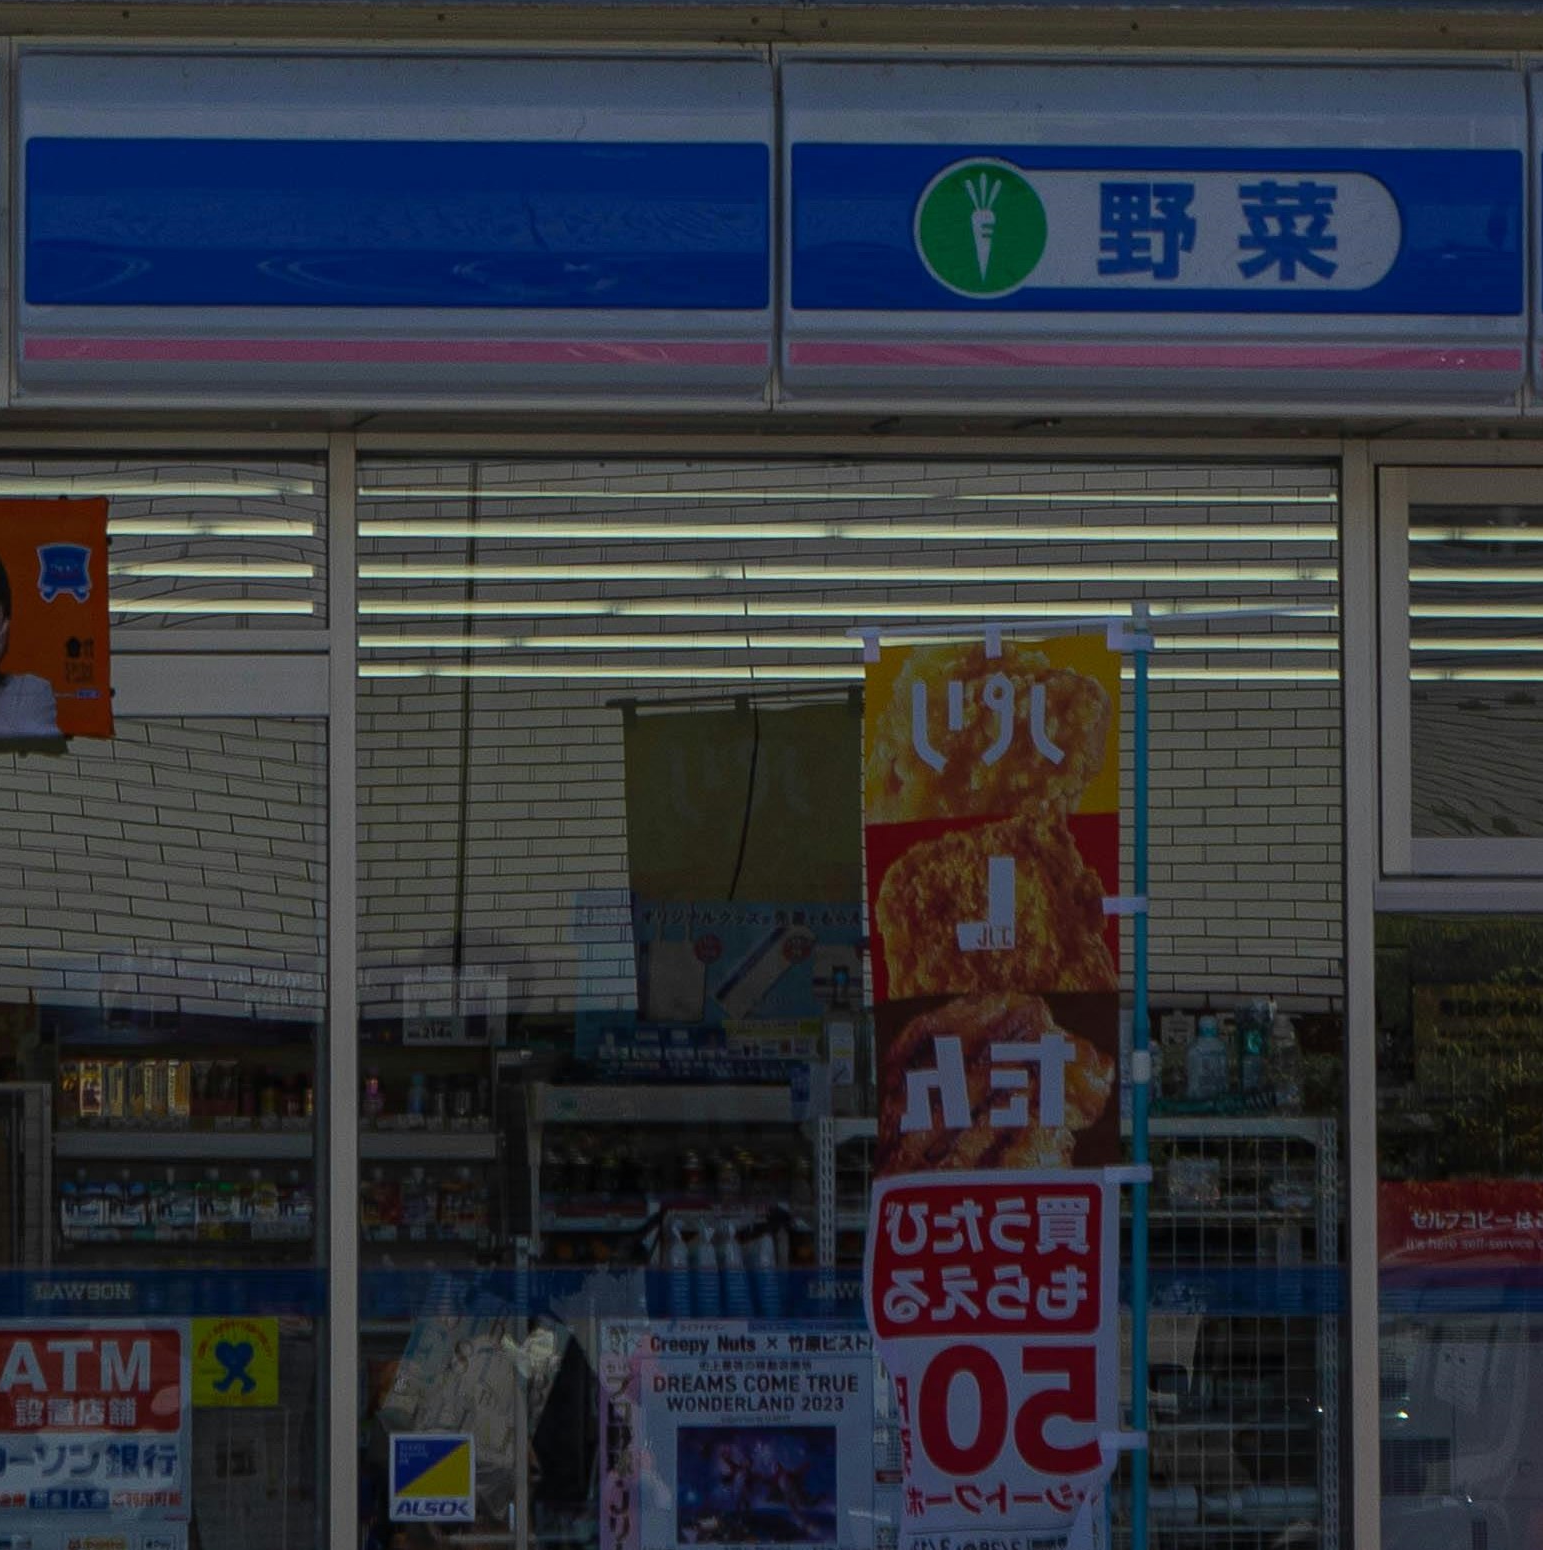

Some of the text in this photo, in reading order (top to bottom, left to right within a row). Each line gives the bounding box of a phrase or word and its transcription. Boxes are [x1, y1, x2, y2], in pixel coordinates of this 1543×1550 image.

[1096, 179, 1340, 282] 野菜
[33, 1282, 132, 1301] LAWSON
[650, 1335, 710, 1353] Creepy
[717, 1335, 756, 1351] Nuts
[787, 1334, 873, 1352] 竹原ピスト
[653, 1374, 860, 1393] DREAMS COME TRUE
[14, 1398, 137, 1427] 設置店舗
[665, 1395, 845, 1413] WONDERLAND 2023
[395, 1500, 471, 1517] ALSOK
